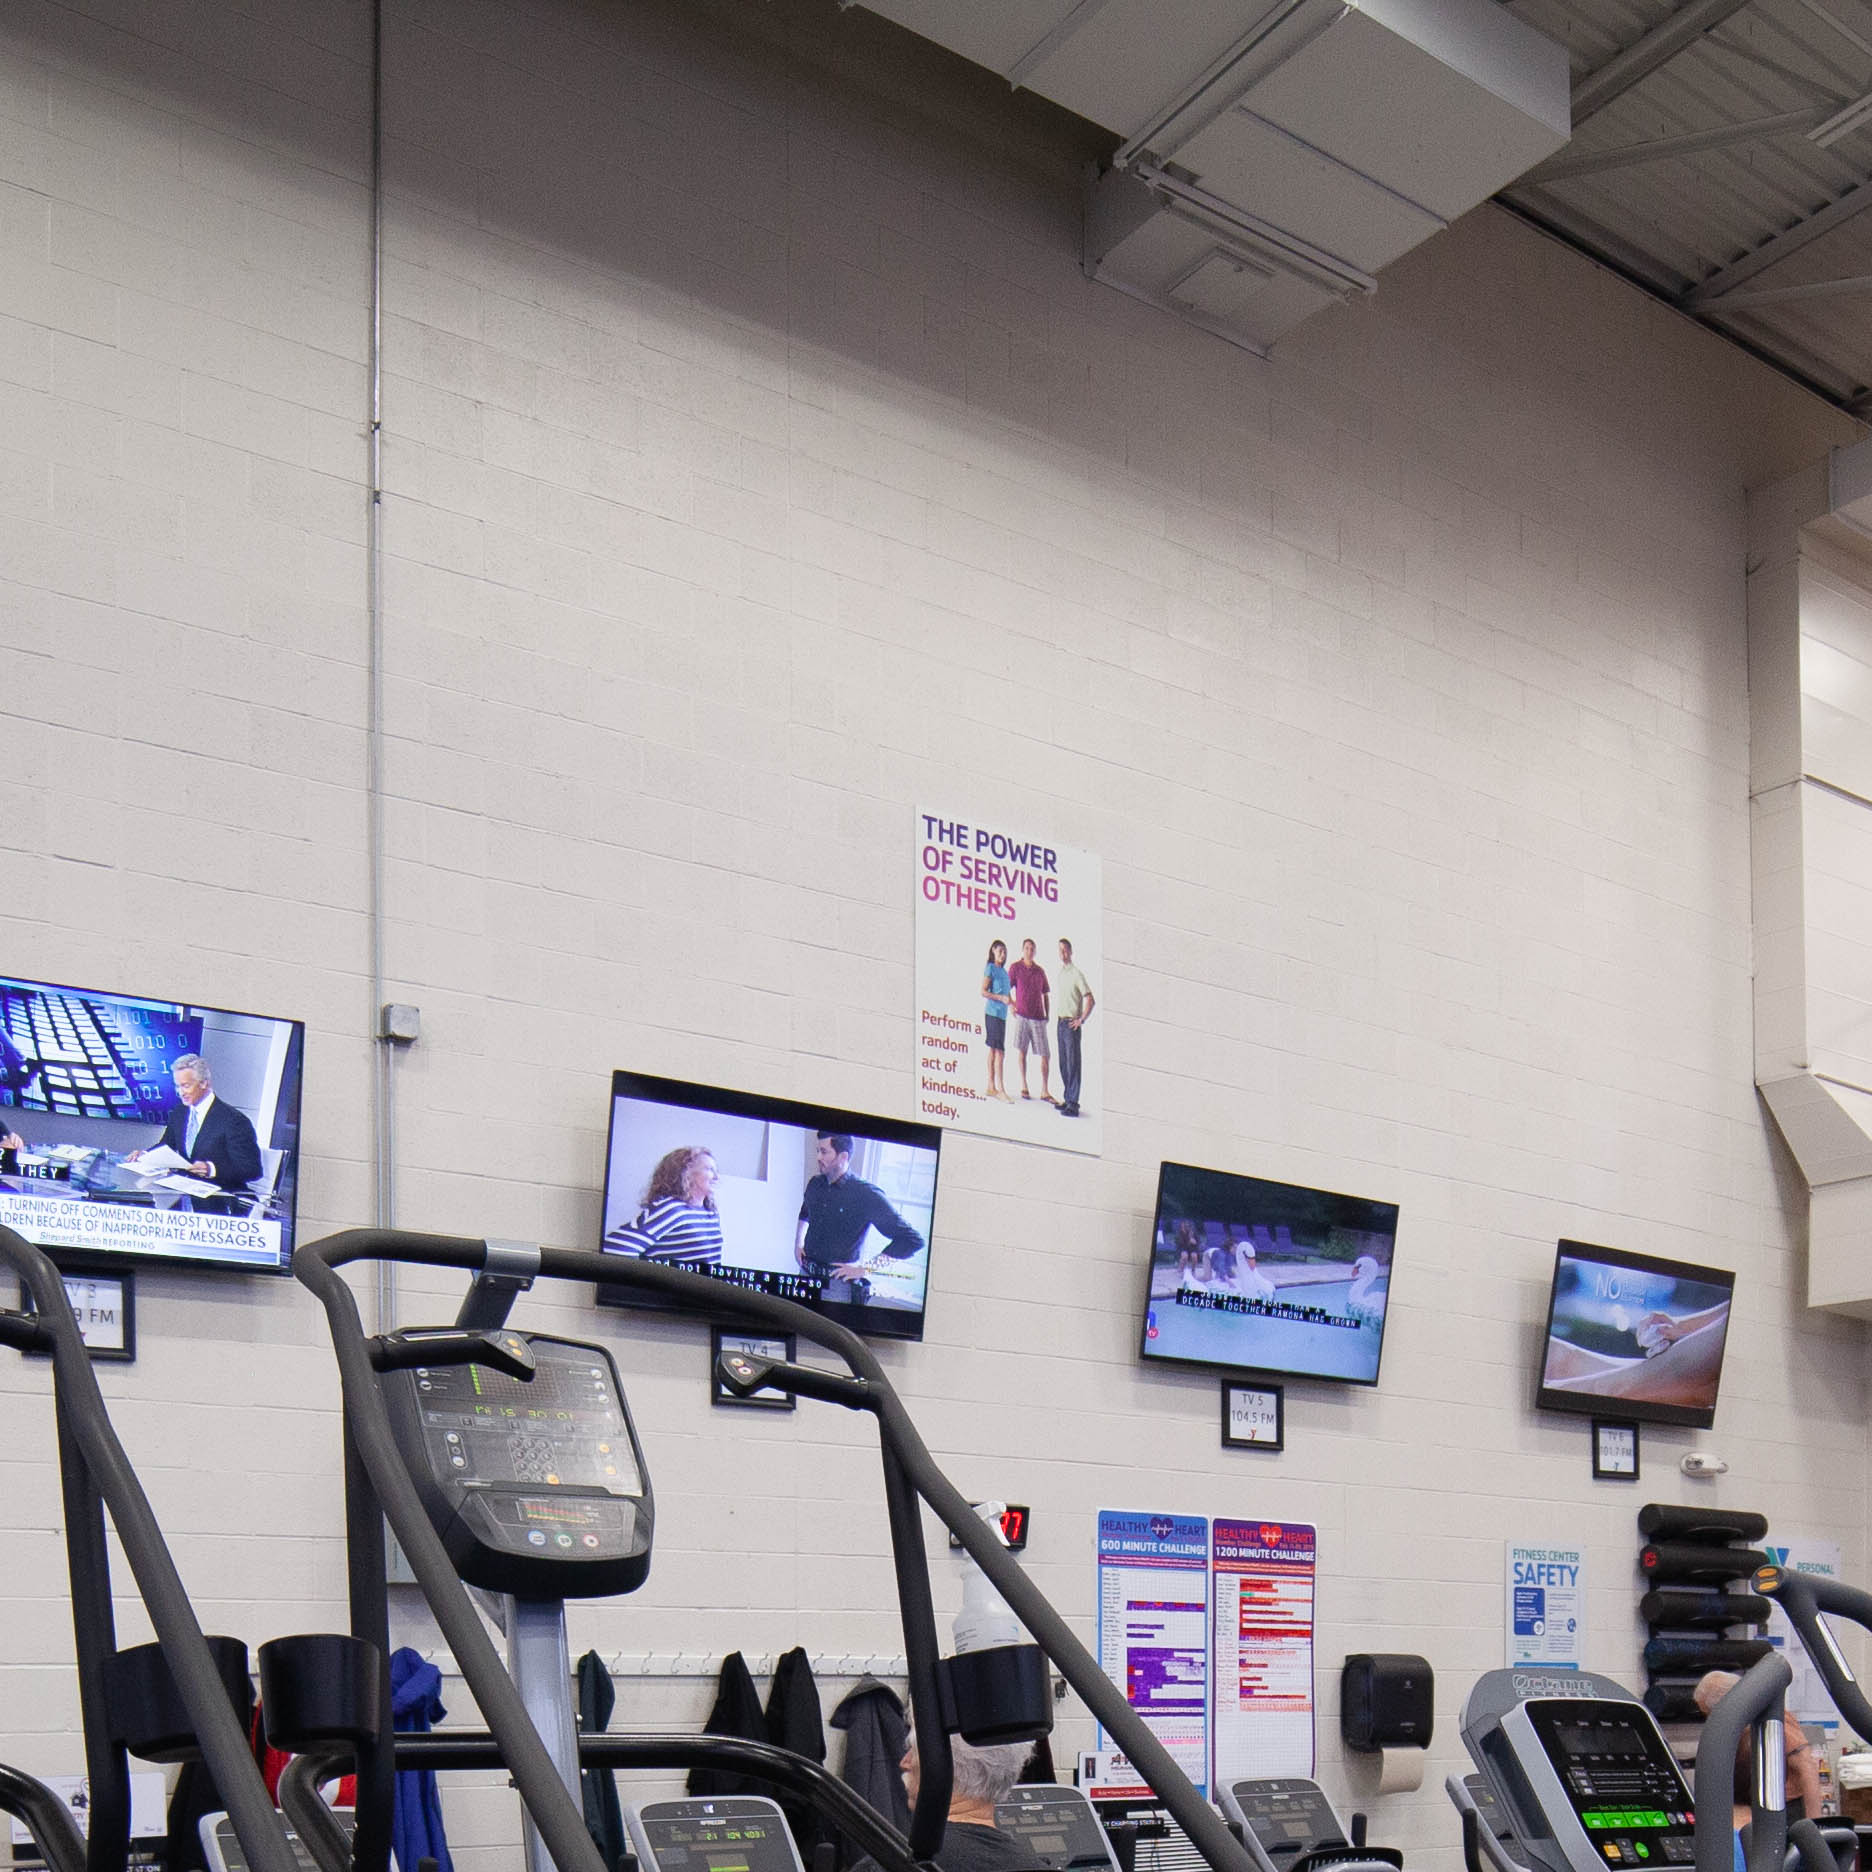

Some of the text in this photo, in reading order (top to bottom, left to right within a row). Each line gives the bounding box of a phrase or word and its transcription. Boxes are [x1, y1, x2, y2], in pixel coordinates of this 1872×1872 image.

[922, 814, 1058, 873] THE POWER
[922, 846, 1058, 903] OF SERVING
[922, 876, 1016, 921] OTHERS
[921, 1010, 982, 1035] Perform a
[921, 1033, 969, 1055] random
[921, 1056, 957, 1073] act of
[921, 1076, 987, 1102] kindness...
[921, 1099, 960, 1121] today.
[18, 1164, 58, 1179] THEY
[8, 1199, 57, 1214] TURNING
[60, 1203, 79, 1216] OFF
[82, 1205, 142, 1223] COMMENTS
[145, 1212, 164, 1224] ON
[167, 1214, 201, 1228] MOST
[205, 1217, 260, 1234] VIDEOS
[36, 1216, 82, 1231] BECAUSE
[84, 1219, 99, 1232] OF
[101, 1221, 186, 1241] INAPPROPRIATE
[189, 1229, 266, 1249] MESSAGES
[679, 1263, 822, 1289] not having a say-so
[88, 1283, 97, 1299] 3
[779, 1286, 813, 1300] like,
[90, 1309, 115, 1325] FM
[1182, 1297, 1216, 1309] DECADE
[1223, 1301, 1266, 1315] TOGETHER
[1272, 1309, 1304, 1321] RAMONA
[740, 1342, 756, 1355] TV
[1242, 1393, 1264, 1407] TV 5
[1231, 1409, 1275, 1425] 104.5 FM
[1101, 1519, 1206, 1537] HEALTHY HEART
[1215, 1527, 1313, 1544] HEALTHY HEART
[1101, 1540, 1207, 1556] 600 MINUTE CHALLENGE
[1215, 1546, 1315, 1562] 1200 MINUTE CHALLENGE
[1513, 1548, 1580, 1562] FITNESS CENTER
[1513, 1562, 1580, 1587] SAFETY
[1796, 1562, 1835, 1575] PERSONAL
